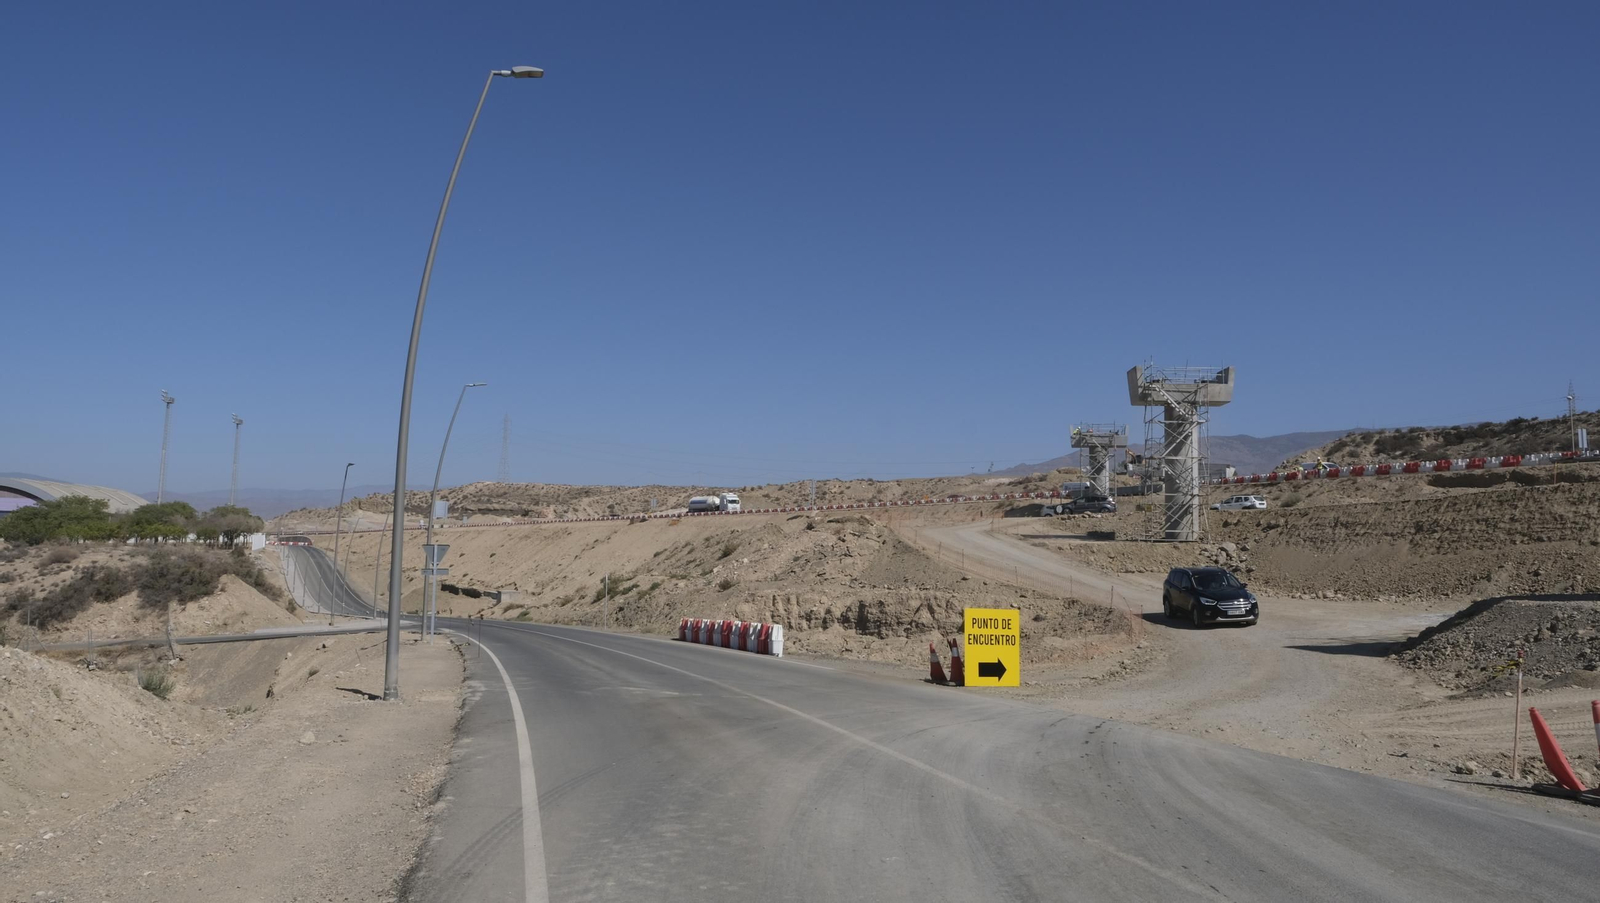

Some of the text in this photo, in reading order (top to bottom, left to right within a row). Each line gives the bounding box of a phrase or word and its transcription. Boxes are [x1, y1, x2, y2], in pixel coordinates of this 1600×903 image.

[972, 618, 1012, 630] PUNTO DE
[968, 634, 1016, 646] ENCUENTRO
